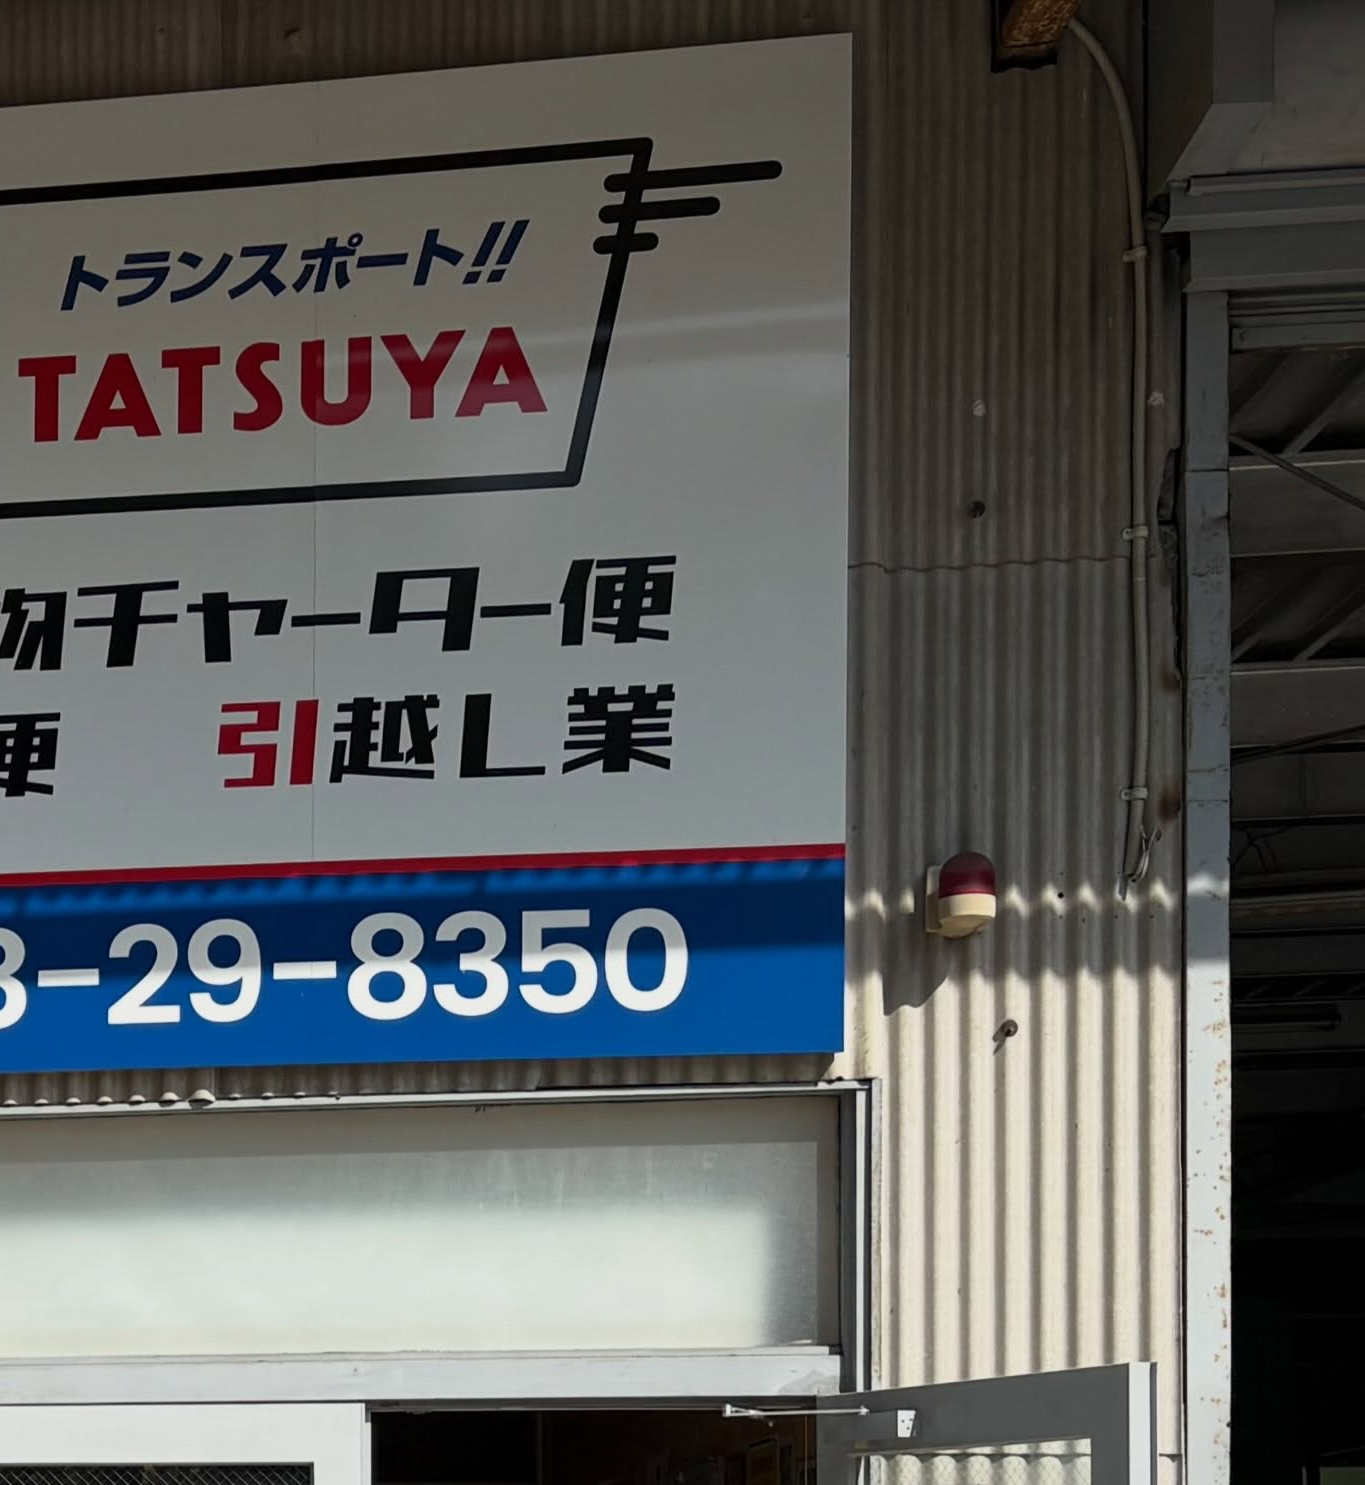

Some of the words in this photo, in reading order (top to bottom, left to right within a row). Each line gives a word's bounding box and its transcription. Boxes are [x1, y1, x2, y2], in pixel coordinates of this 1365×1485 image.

[60, 219, 530, 311] トランスポート!!
[18, 326, 547, 444] TATSUYA
[217, 683, 676, 788] 引越し業
